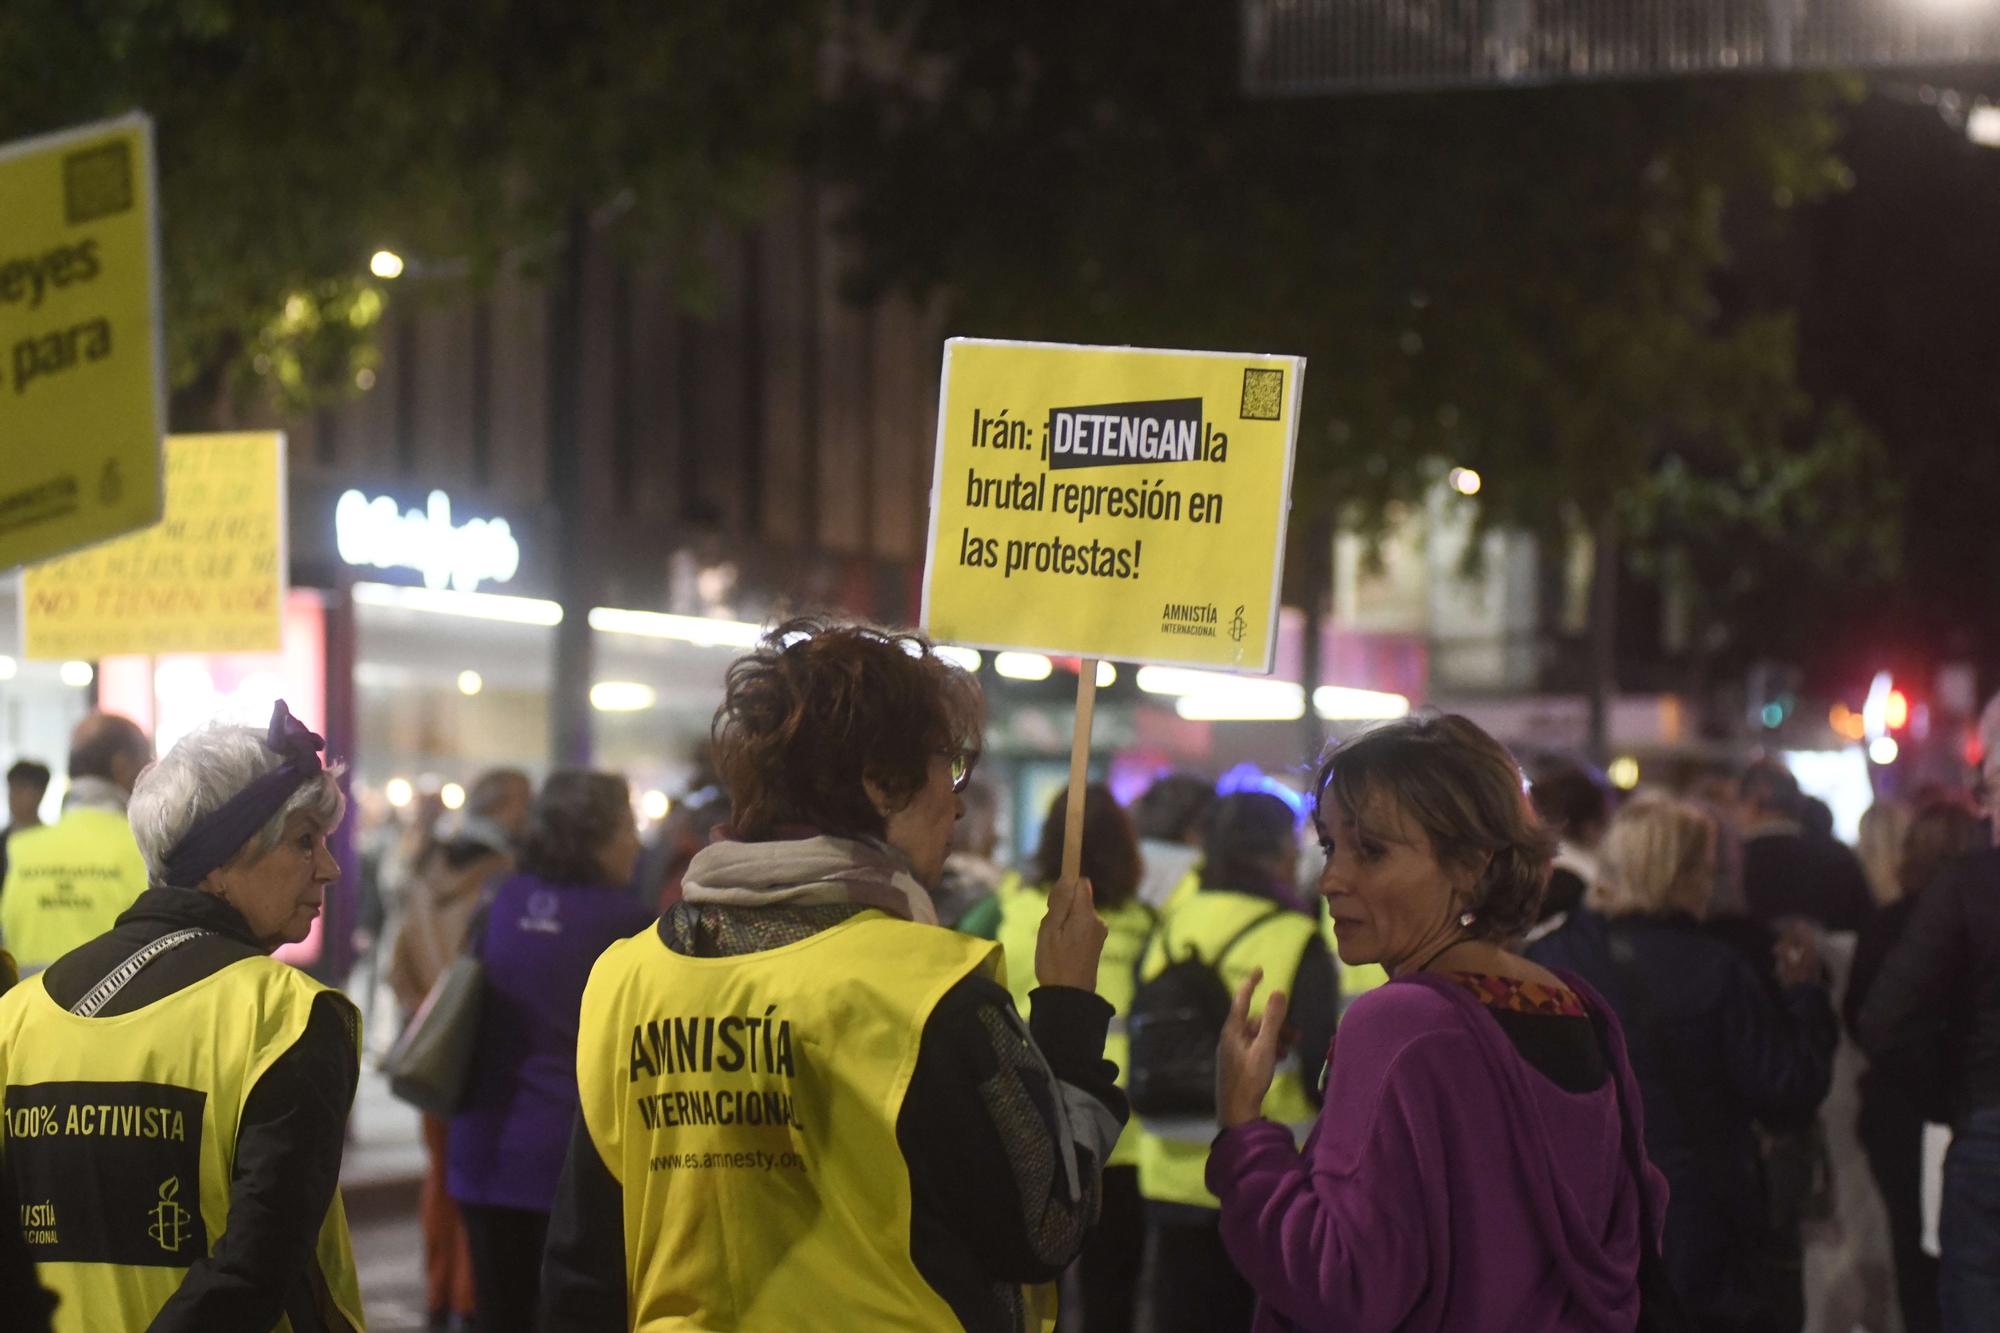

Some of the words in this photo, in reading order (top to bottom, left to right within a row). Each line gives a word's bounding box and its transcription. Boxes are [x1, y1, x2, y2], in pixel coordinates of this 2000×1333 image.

[13, 314, 112, 396] para
[971, 408, 1033, 451] Irán:
[1202, 422, 1229, 463] la
[966, 468, 1046, 510] brutal
[1051, 479, 1181, 523] represión
[1188, 492, 1223, 524] en
[959, 526, 999, 568] las
[1004, 535, 1142, 579] protestas!
[1161, 623, 1217, 637] INTERNACIONAL
[1162, 603, 1218, 624] AMNISTÍA
[630, 1004, 795, 1083] AMNISTÍA
[5, 1105, 58, 1138] 100%
[65, 1105, 184, 1142] ACTIVISTA
